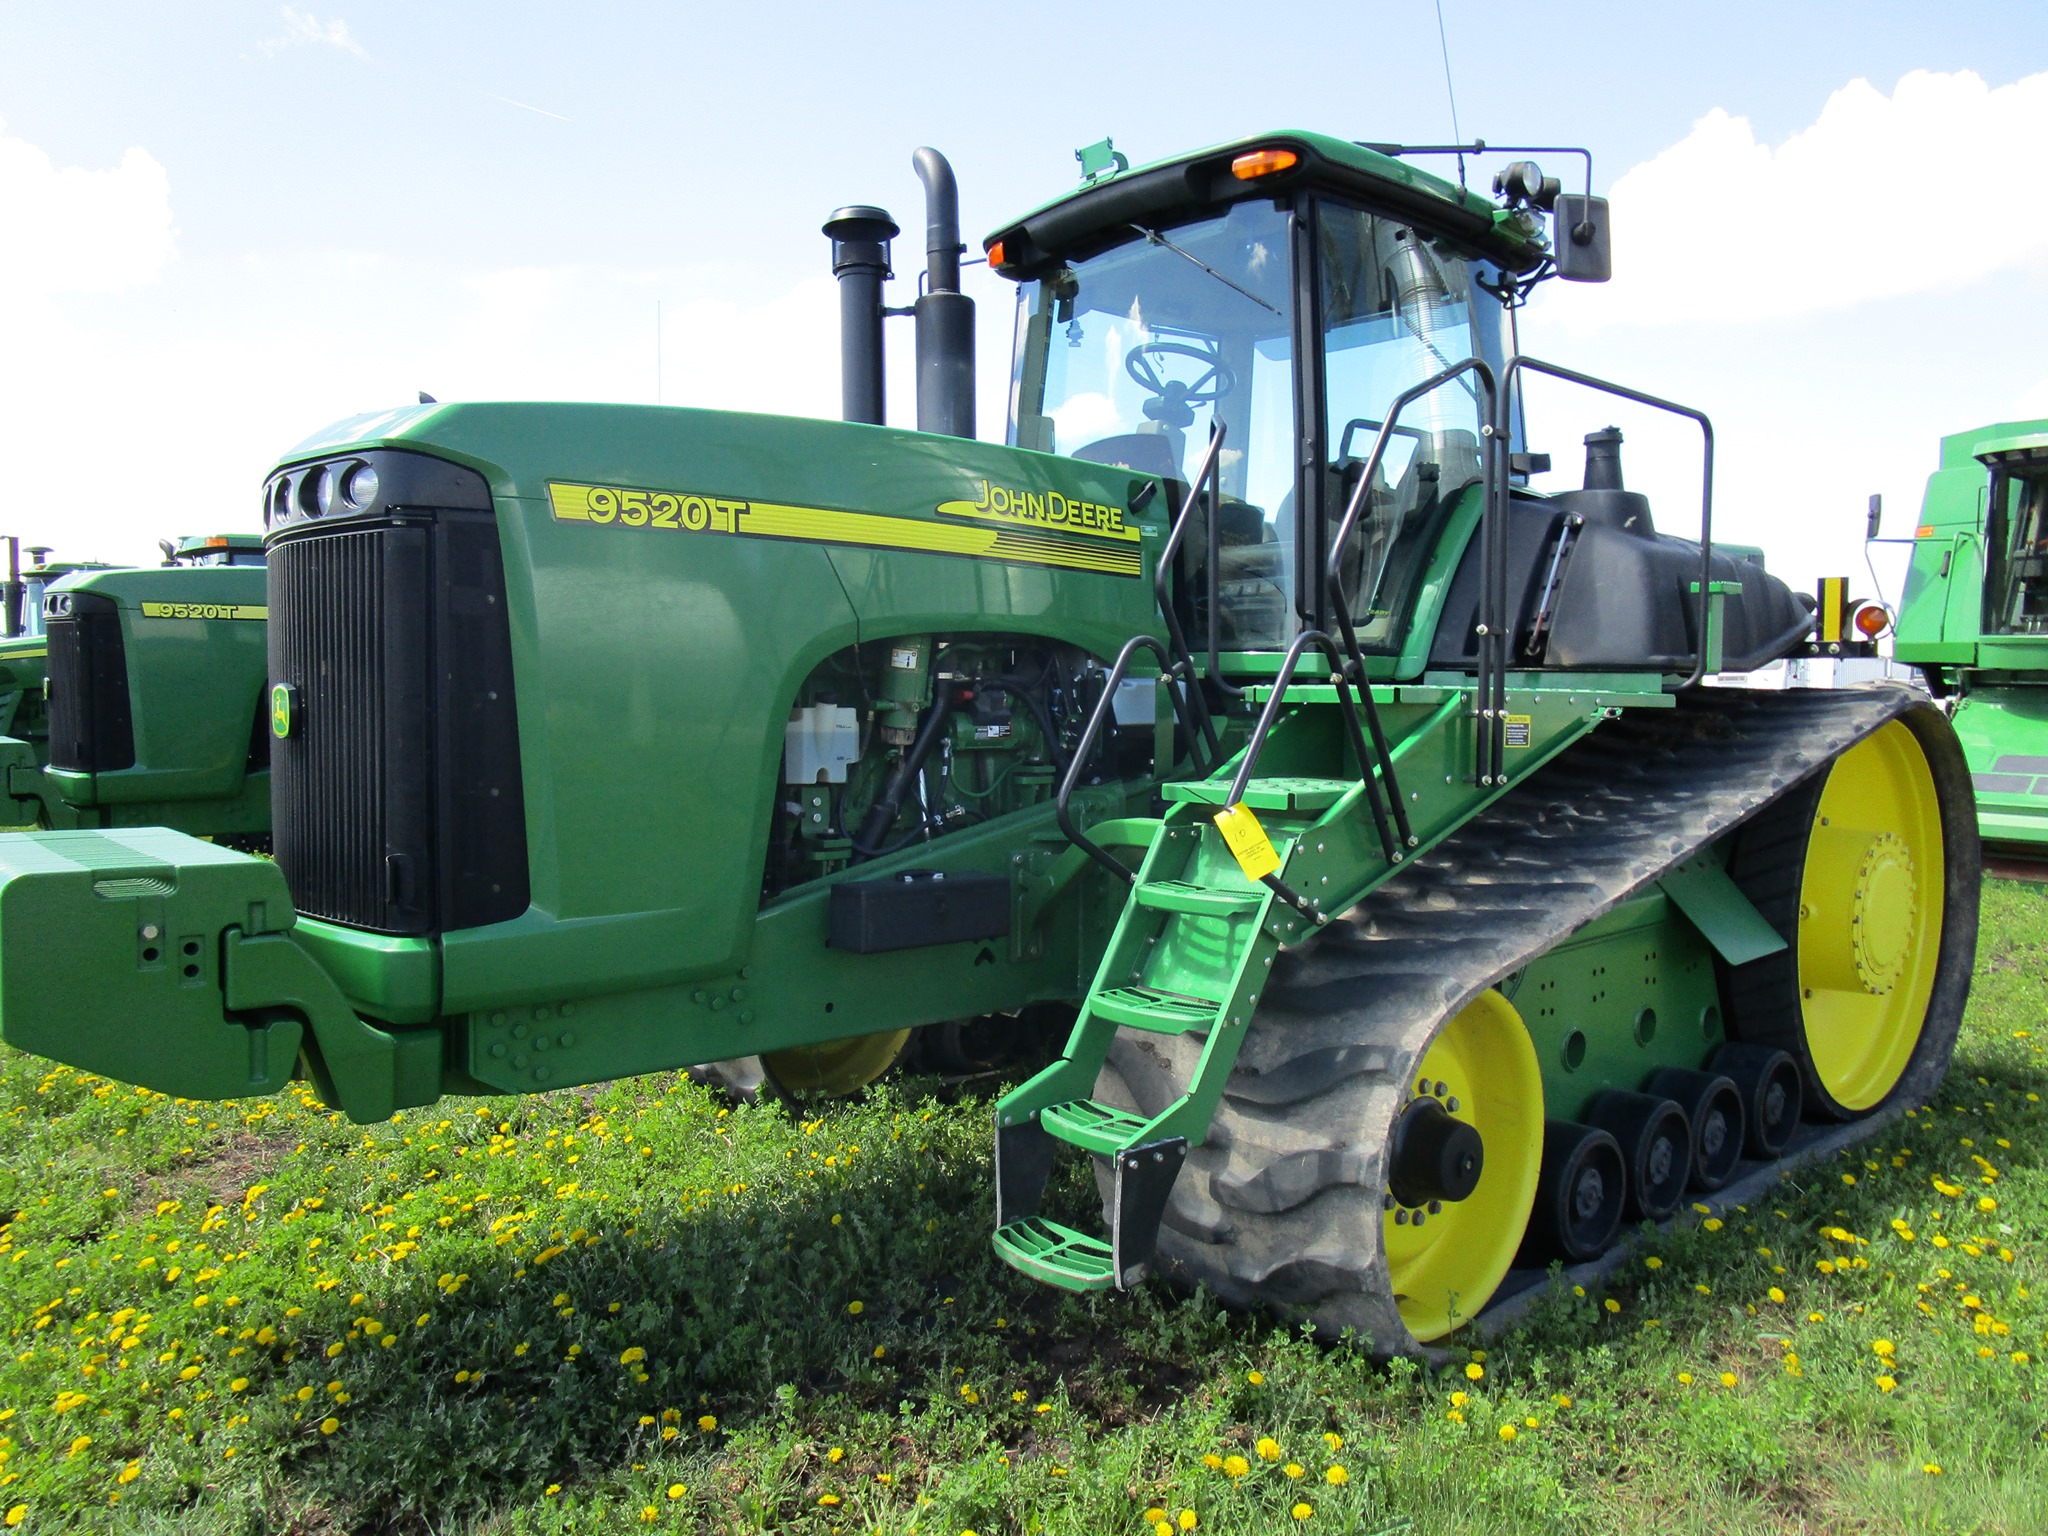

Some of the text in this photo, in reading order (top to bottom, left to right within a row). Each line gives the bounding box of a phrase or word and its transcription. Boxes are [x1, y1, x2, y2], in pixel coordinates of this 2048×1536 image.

[587, 487, 748, 534] 9520T
[975, 479, 1125, 532] JOHN DEERE
[160, 603, 238, 620] 9520T
